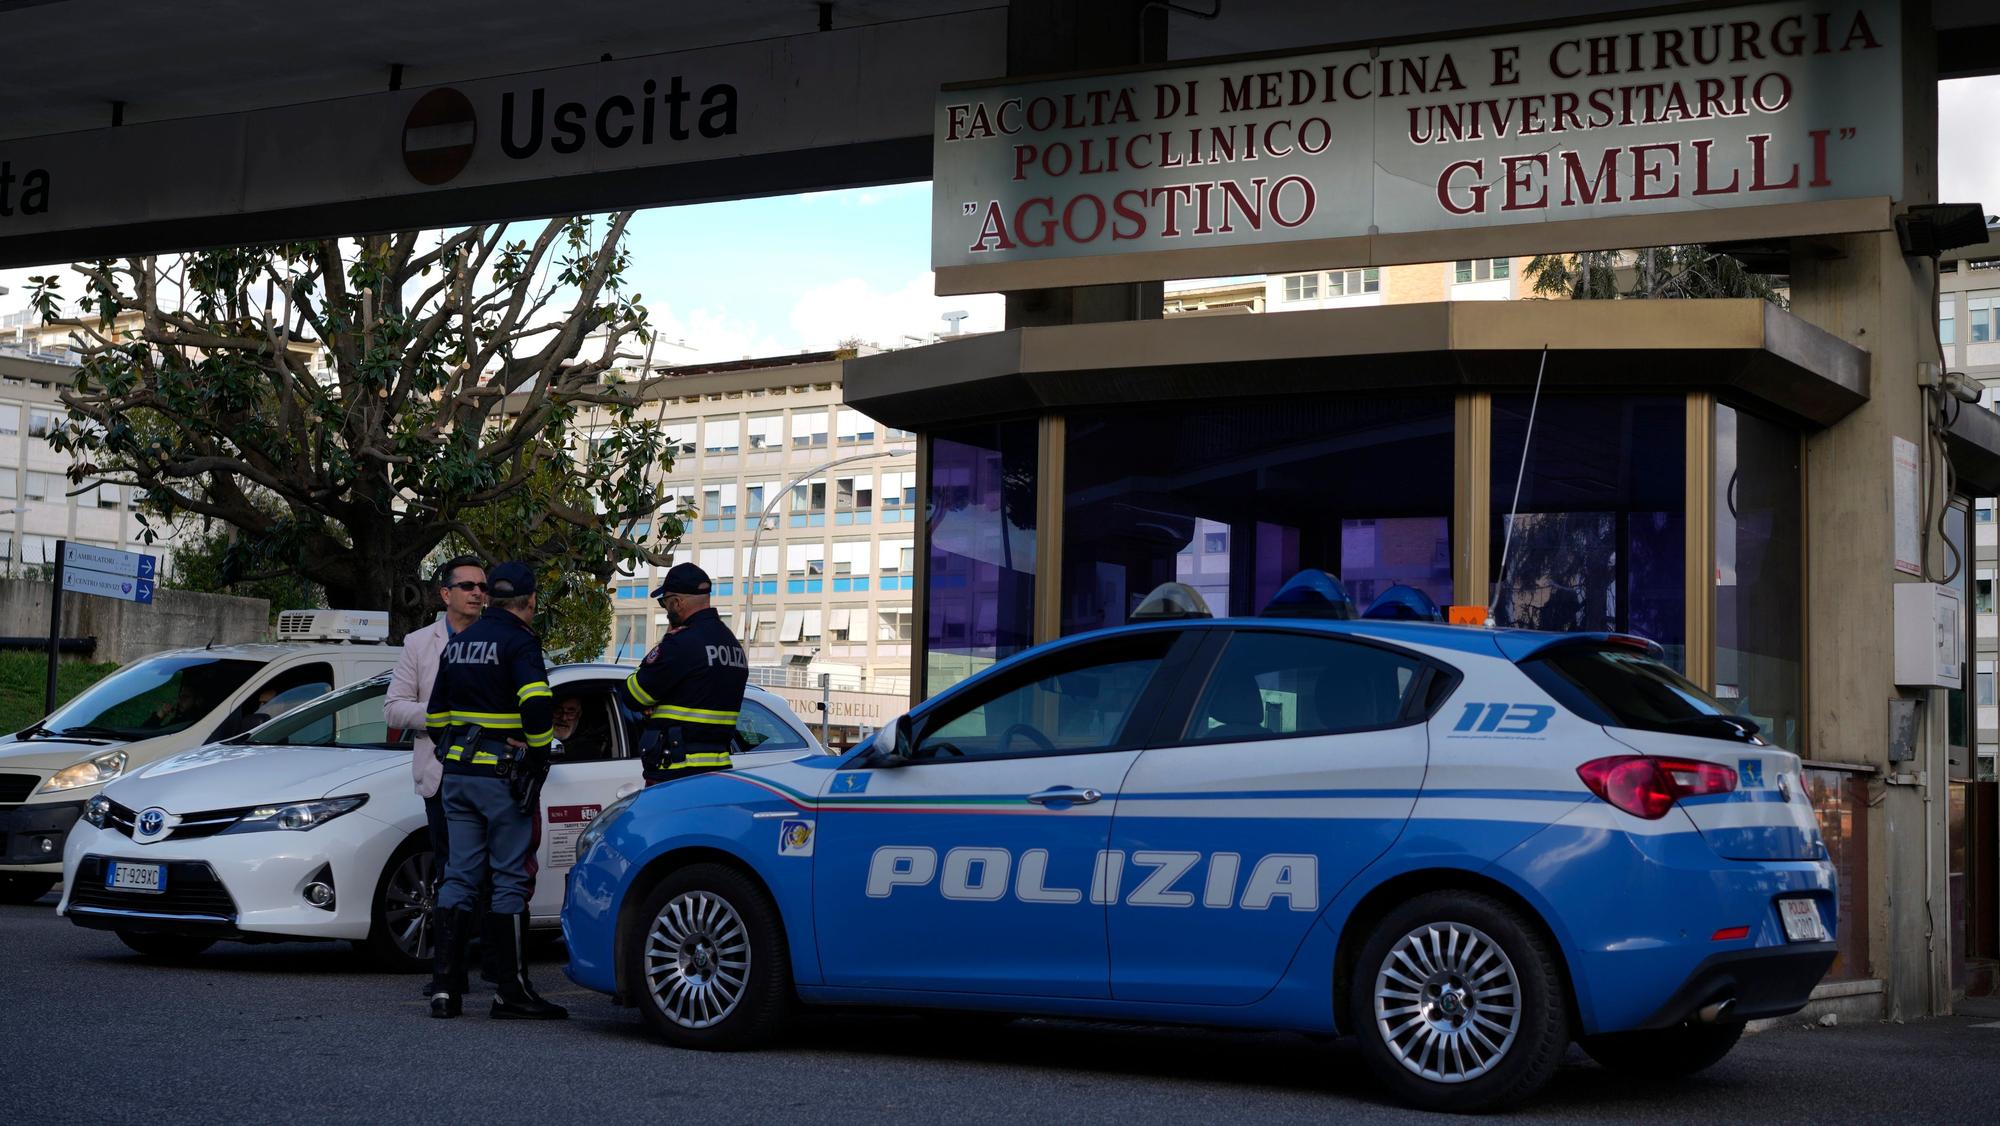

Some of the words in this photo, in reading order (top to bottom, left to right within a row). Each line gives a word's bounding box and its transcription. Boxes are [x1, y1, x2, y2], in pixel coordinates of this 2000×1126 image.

[945, 86, 1140, 142] FACOLTÀ
[1153, 80, 1199, 120] DI
[1219, 53, 1467, 115] MEDICINA
[1490, 45, 1521, 87] E
[1549, 9, 1883, 80] CHIRURGIA
[499, 77, 739, 159] Uscita
[1012, 117, 1332, 181] POLICLINICO
[1407, 72, 1793, 145] UNIVERSITARIO
[0, 160, 50, 216] ta
[75, 577, 98, 588] CENTRO
[99, 580, 120, 590] SERVIZI
[77, 553, 115, 565] AMBULATORI
[829, 702, 879, 717] GEMELLI
[1453, 702, 1556, 733] 113
[865, 844, 1319, 911] POLIZIA
